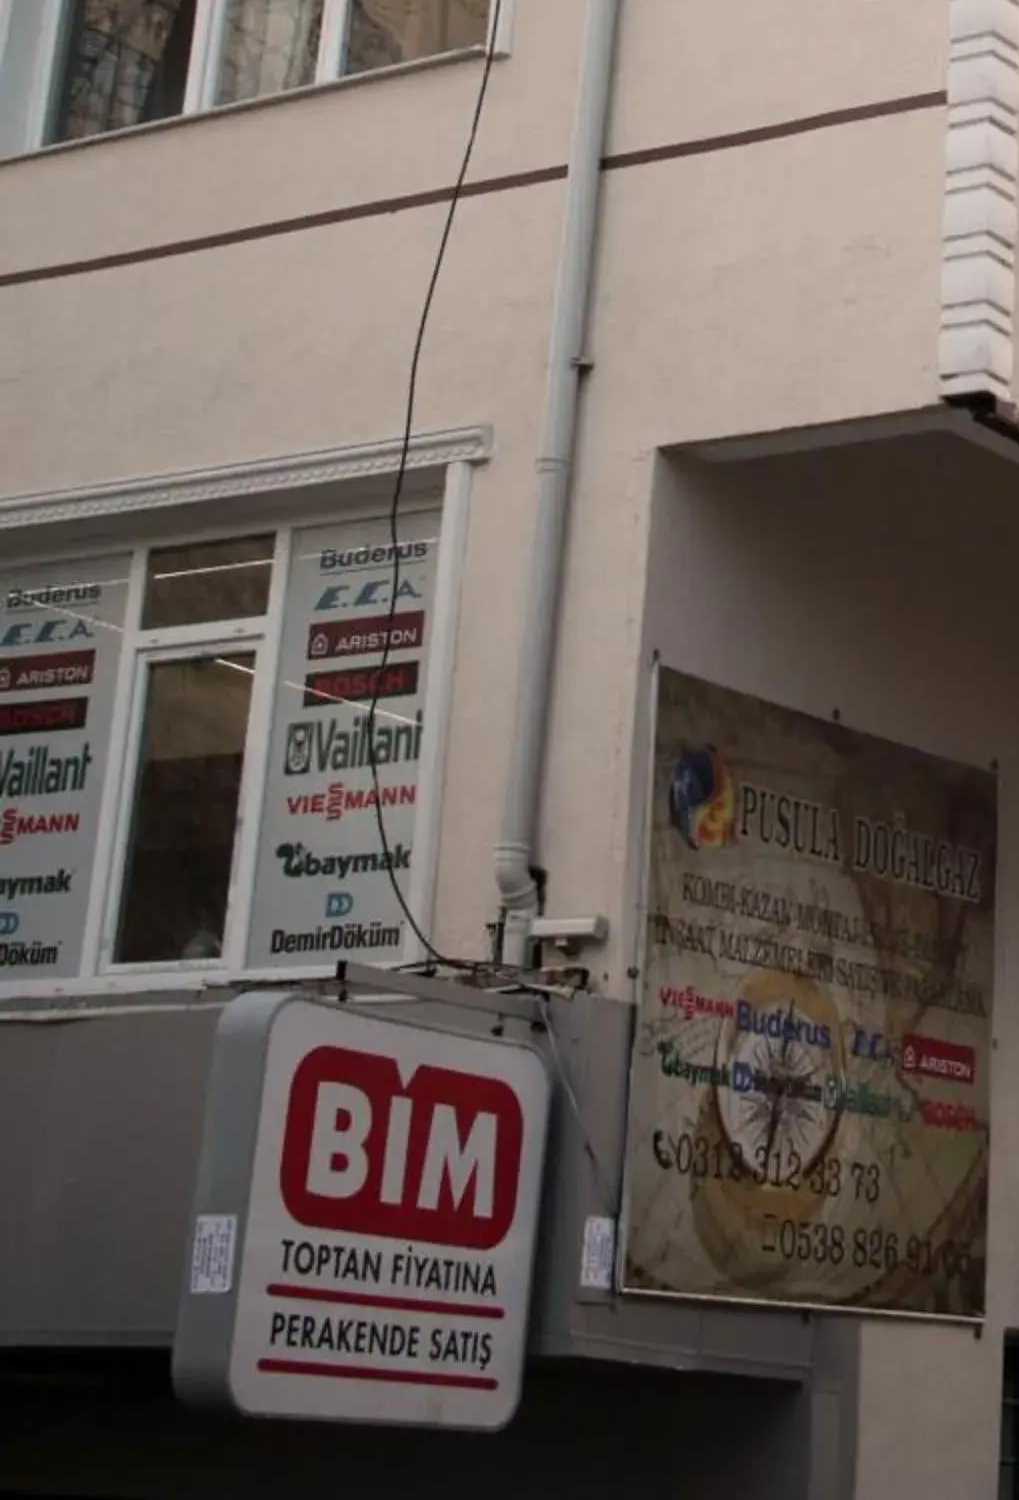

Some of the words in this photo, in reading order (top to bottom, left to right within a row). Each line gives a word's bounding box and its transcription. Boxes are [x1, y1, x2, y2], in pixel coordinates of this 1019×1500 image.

[320, 542, 427, 569] Buderus
[6, 584, 102, 608] Buderus
[335, 628, 417, 651] ARISTON
[16, 665, 89, 686] ARISTON
[315, 671, 405, 699] BOSCH
[316, 708, 424, 773] Vaillant
[287, 781, 417, 821] VIESSMANN
[741, 785, 841, 861] PUSULA
[303, 844, 411, 879] baymak
[271, 922, 400, 954] DemirDöküm
[736, 1000, 831, 1049] Buderus
[919, 1055, 971, 1079] ARISTON
[753, 1145, 801, 1190] 312
[851, 1161, 882, 1203] 73
[779, 1219, 845, 1265] 0538
[851, 1228, 899, 1271] 826
[282, 1239, 383, 1284] TOPTAN
[389, 1245, 498, 1296] FİYATINA
[269, 1312, 420, 1359] PERAKENDE
[429, 1328, 494, 1371] SATIŞ
